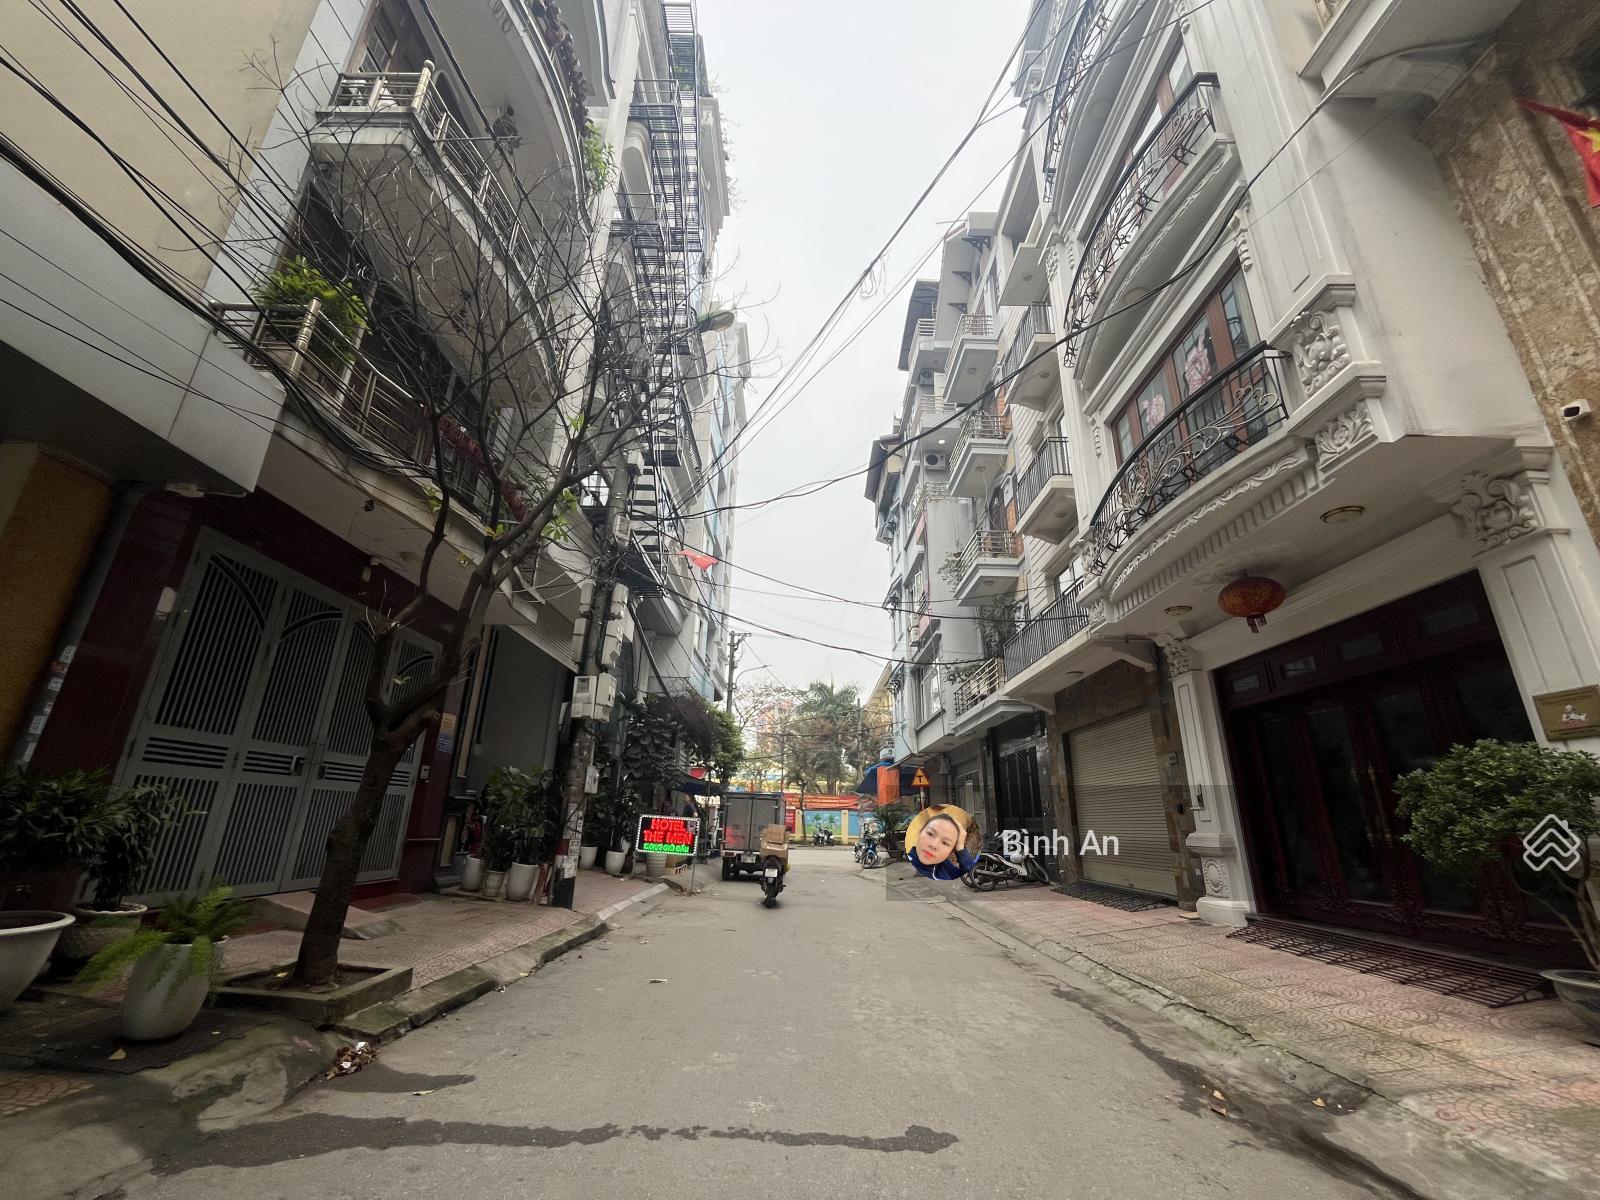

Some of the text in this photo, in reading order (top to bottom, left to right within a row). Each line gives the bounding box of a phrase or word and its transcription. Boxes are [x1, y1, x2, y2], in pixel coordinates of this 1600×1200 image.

[651, 818, 686, 831] HOTEL
[643, 830, 694, 845] THE MEN
